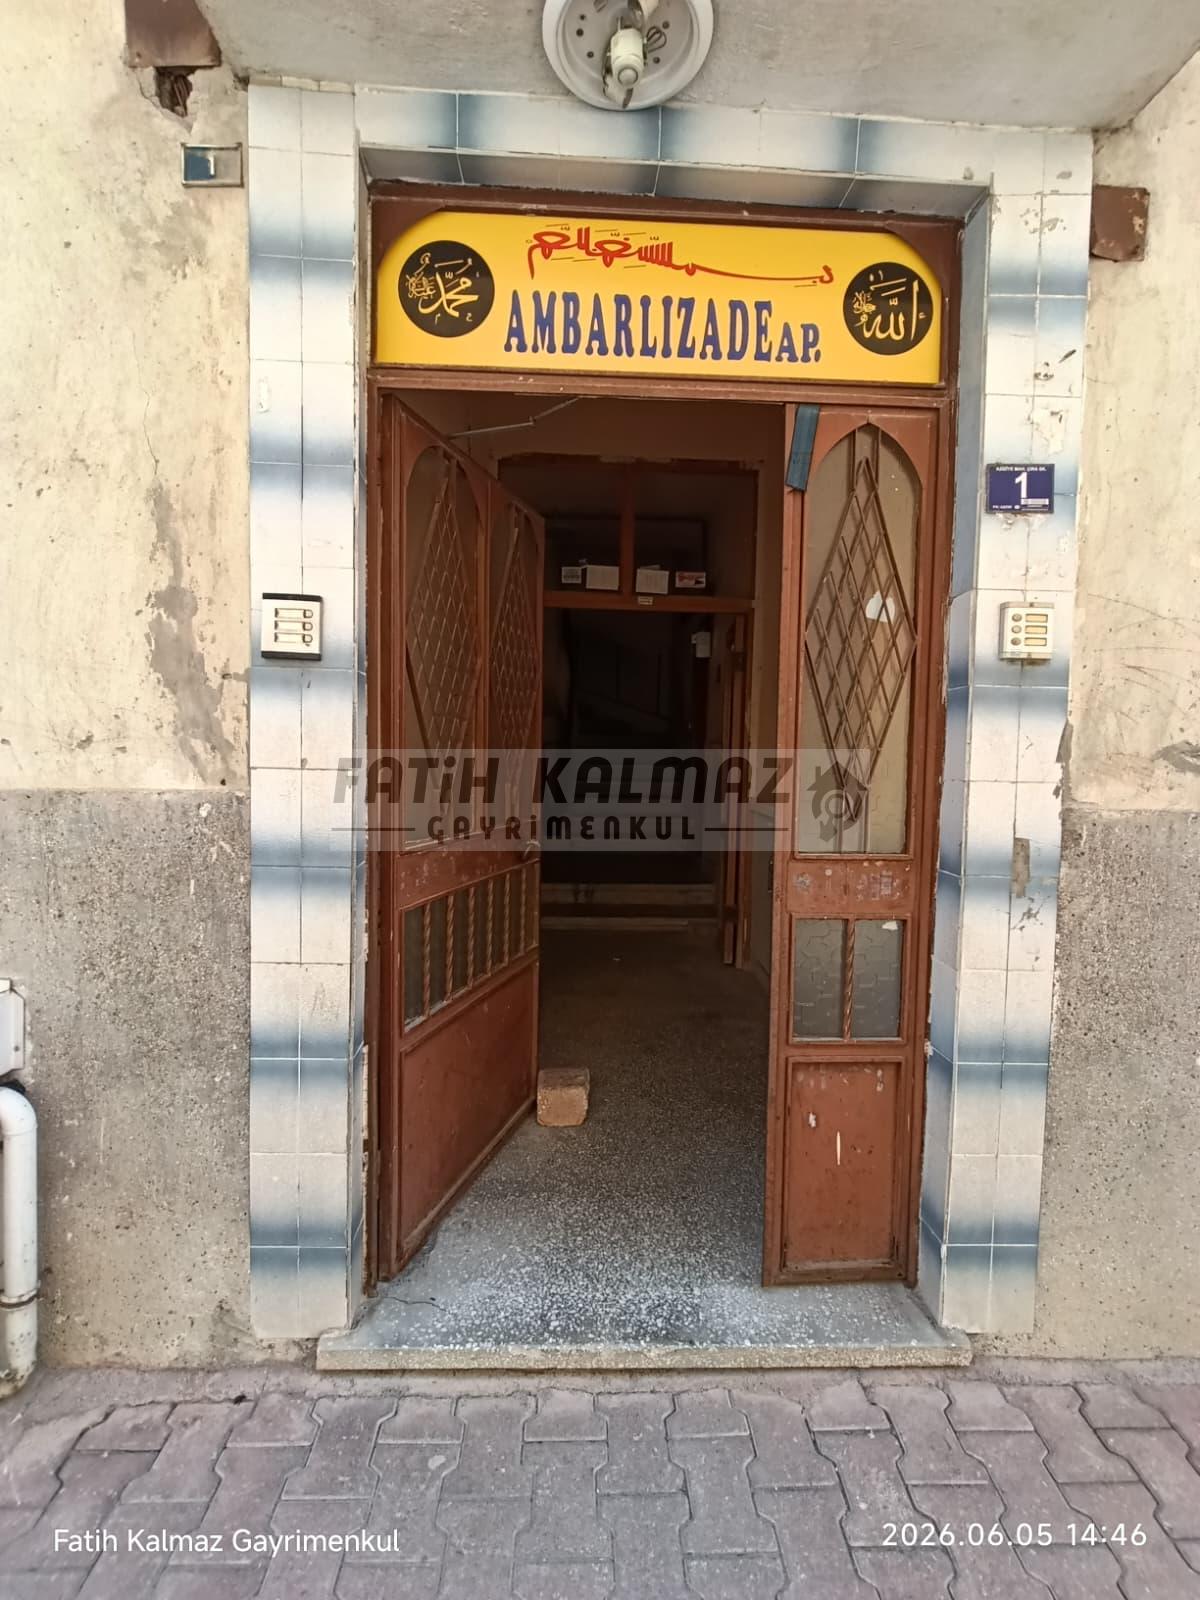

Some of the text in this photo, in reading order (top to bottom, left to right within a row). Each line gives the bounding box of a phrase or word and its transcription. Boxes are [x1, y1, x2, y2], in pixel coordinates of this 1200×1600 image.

[504, 289, 821, 363] AMBARLIZADE AP.
[1014, 472, 1028, 498] 1
